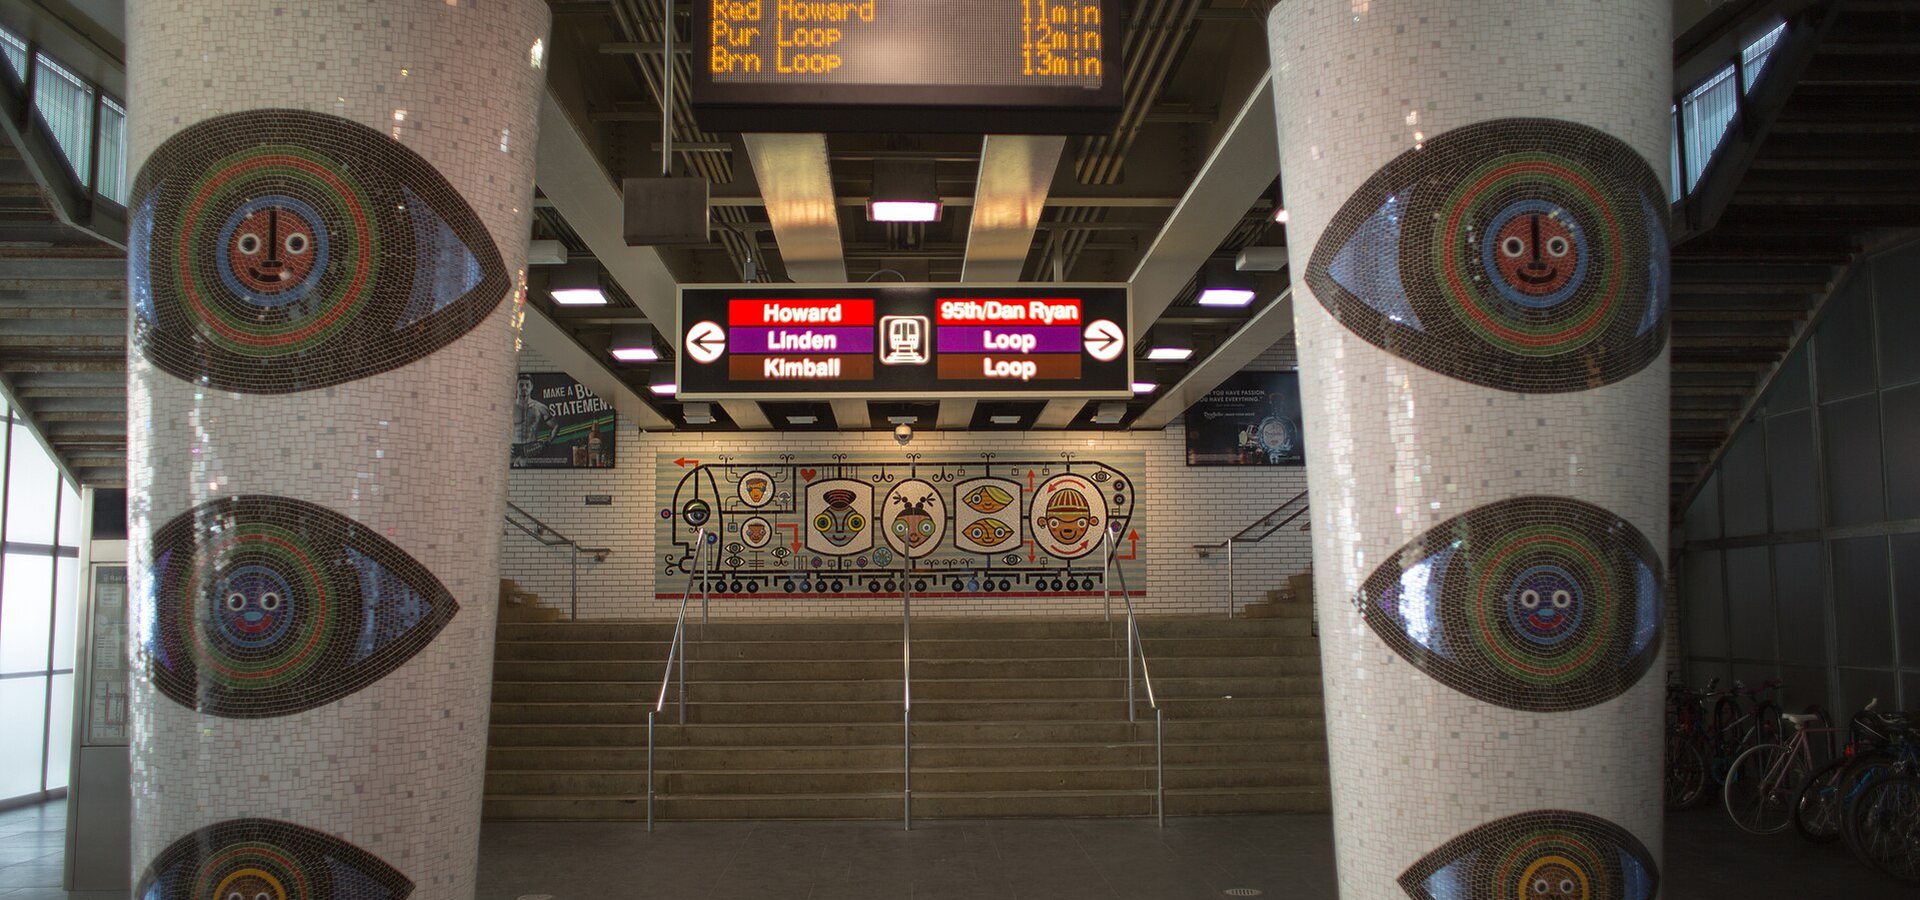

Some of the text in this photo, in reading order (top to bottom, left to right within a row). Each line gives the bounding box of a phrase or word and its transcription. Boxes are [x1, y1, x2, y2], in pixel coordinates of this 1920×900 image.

[712, 0, 761, 20] Red
[777, 0, 875, 21] Howard
[712, 20, 1101, 50] Pur Loop 12min
[711, 45, 1102, 76] Brn Loop 13min
[763, 303, 842, 322] Howard
[940, 301, 1079, 325] 95th/Dan Ryan
[767, 330, 837, 350] Linden
[983, 330, 1037, 353] Loop
[763, 358, 841, 377] Kimball
[983, 357, 1037, 381] Loop
[543, 388, 565, 399] MAKE
[567, 386, 573, 396] A
